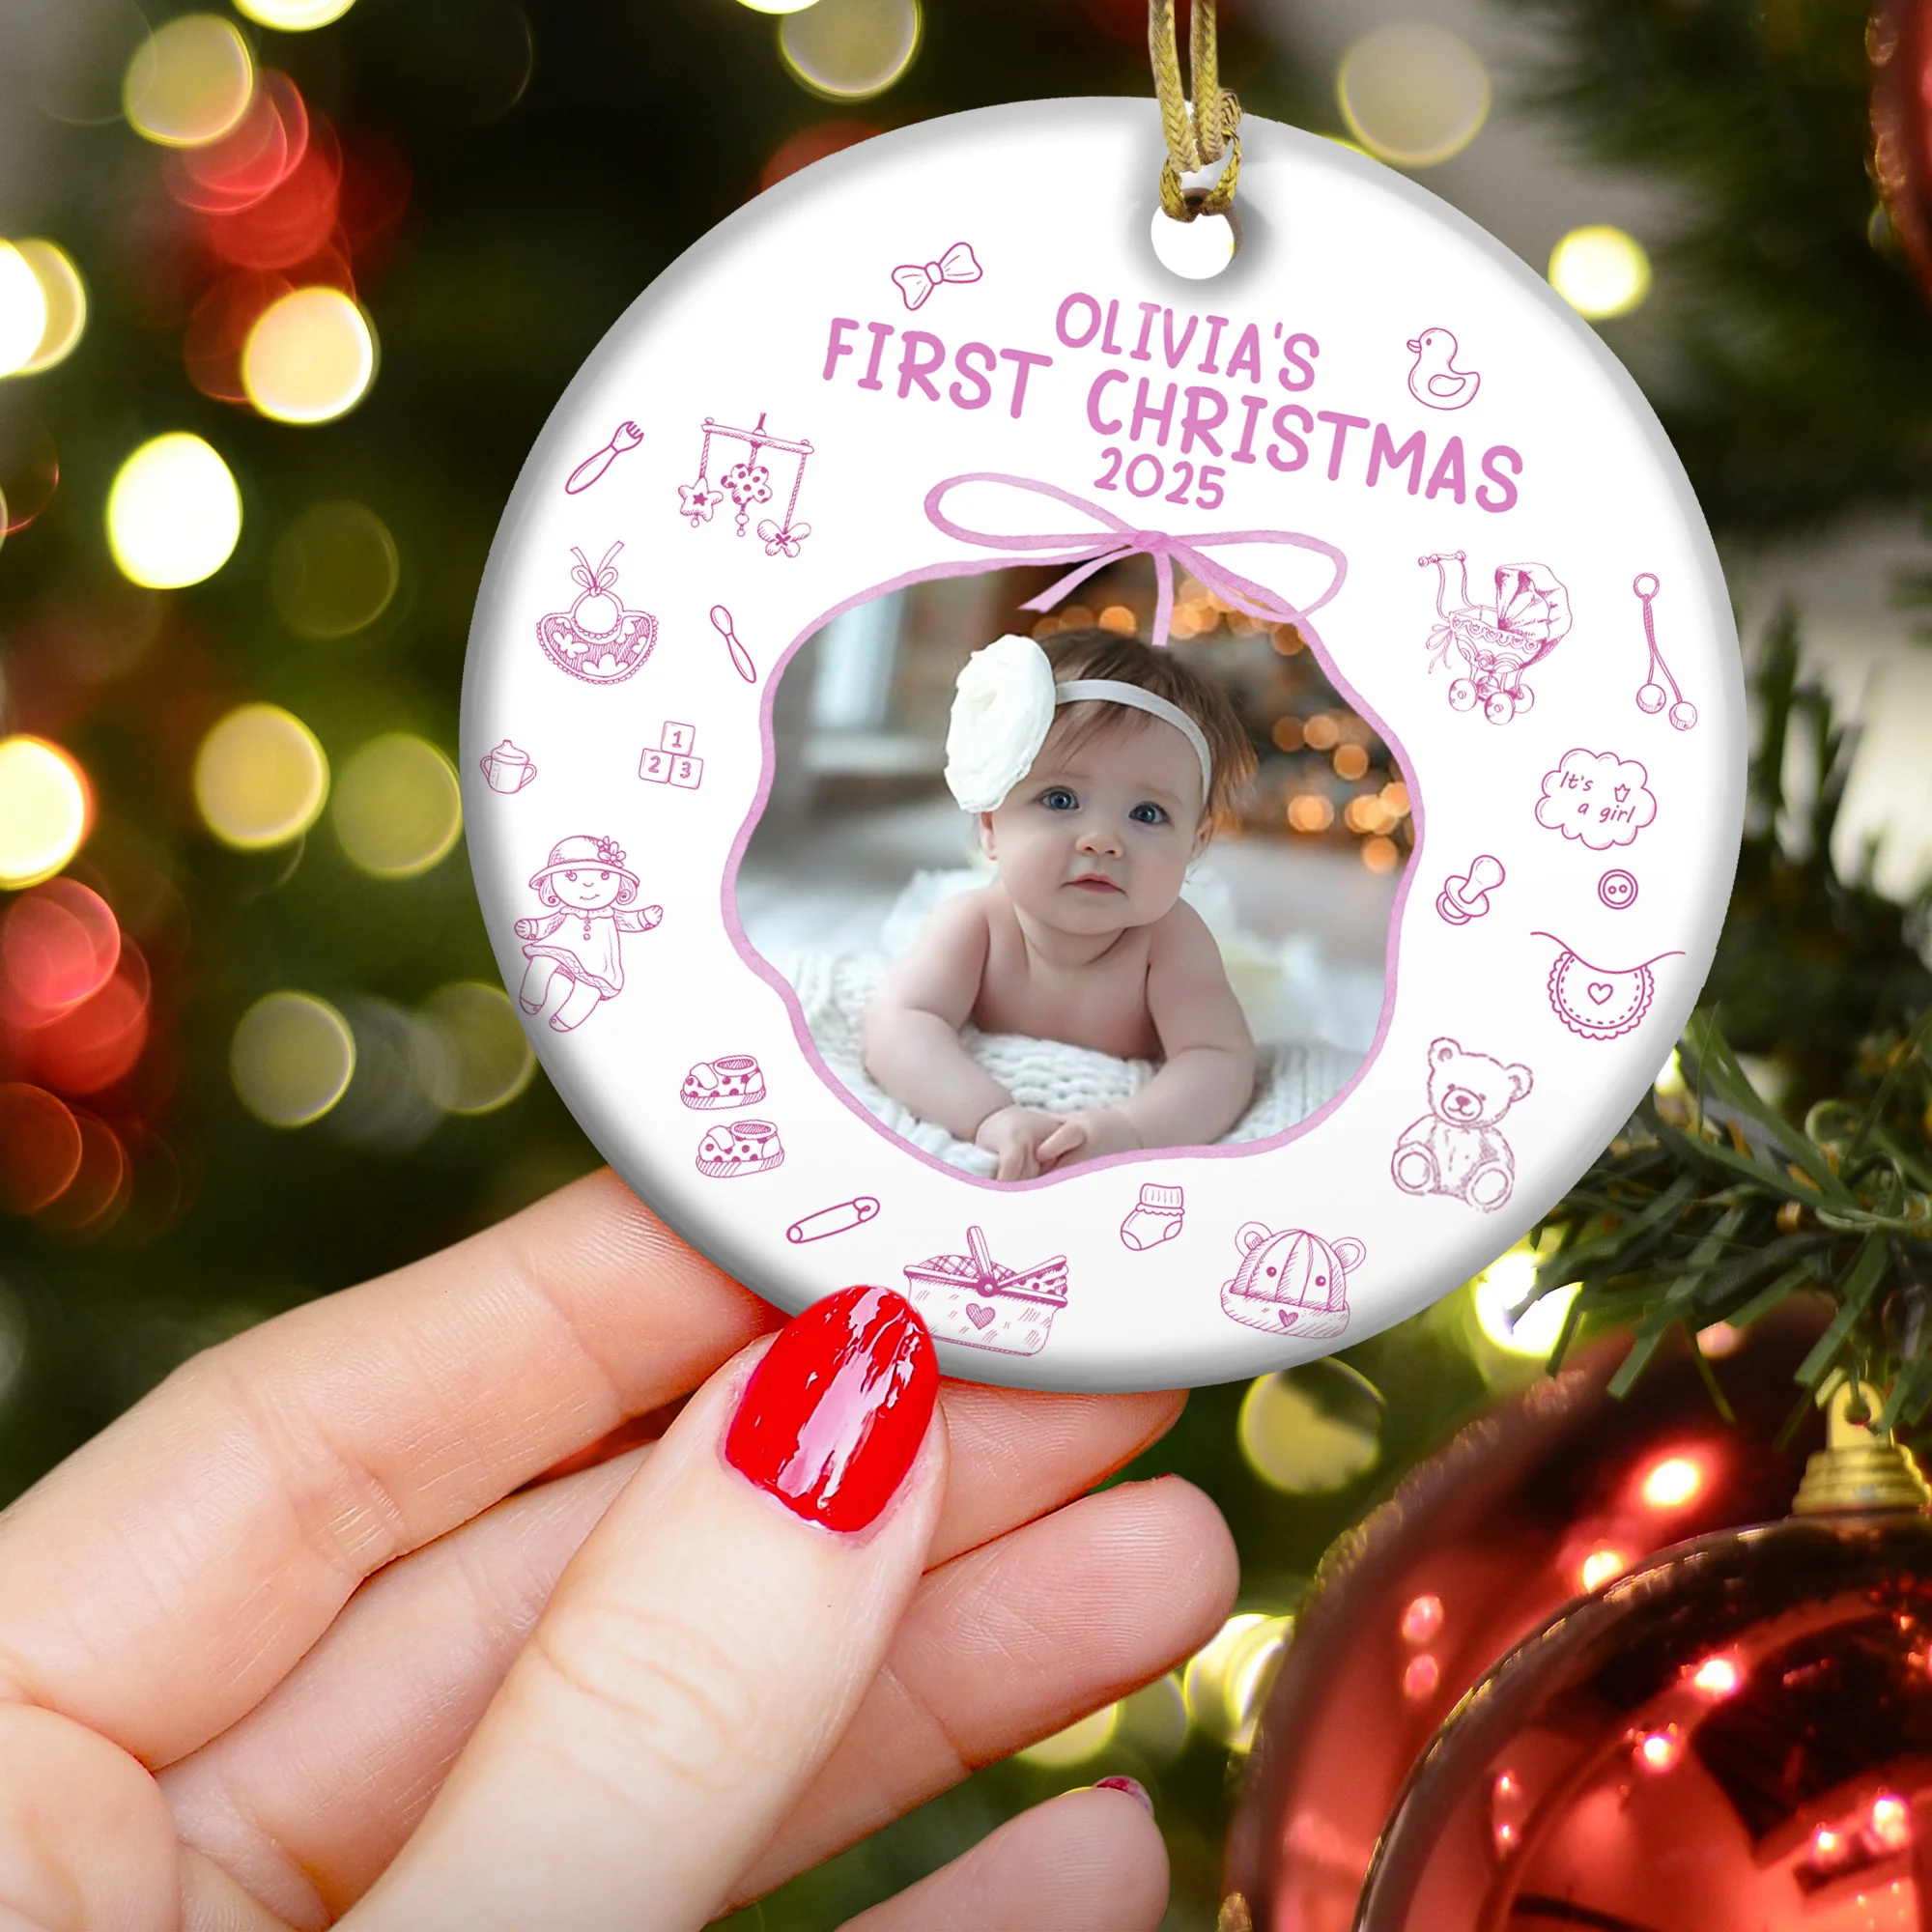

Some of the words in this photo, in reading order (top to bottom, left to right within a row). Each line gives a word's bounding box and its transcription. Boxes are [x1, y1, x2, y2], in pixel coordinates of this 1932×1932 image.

[1056, 292, 1321, 392] OLIVIA'S
[822, 317, 1054, 419] FIRST
[1086, 368, 1524, 514] CHRISTMAS
[1093, 446, 1226, 510] 2025
[671, 730, 682, 749] 1
[648, 754, 661, 774] 2
[679, 761, 692, 780] 3
[1560, 770, 1594, 792] It's
[1577, 803, 1590, 815] a
[1599, 804, 1636, 824] girl
